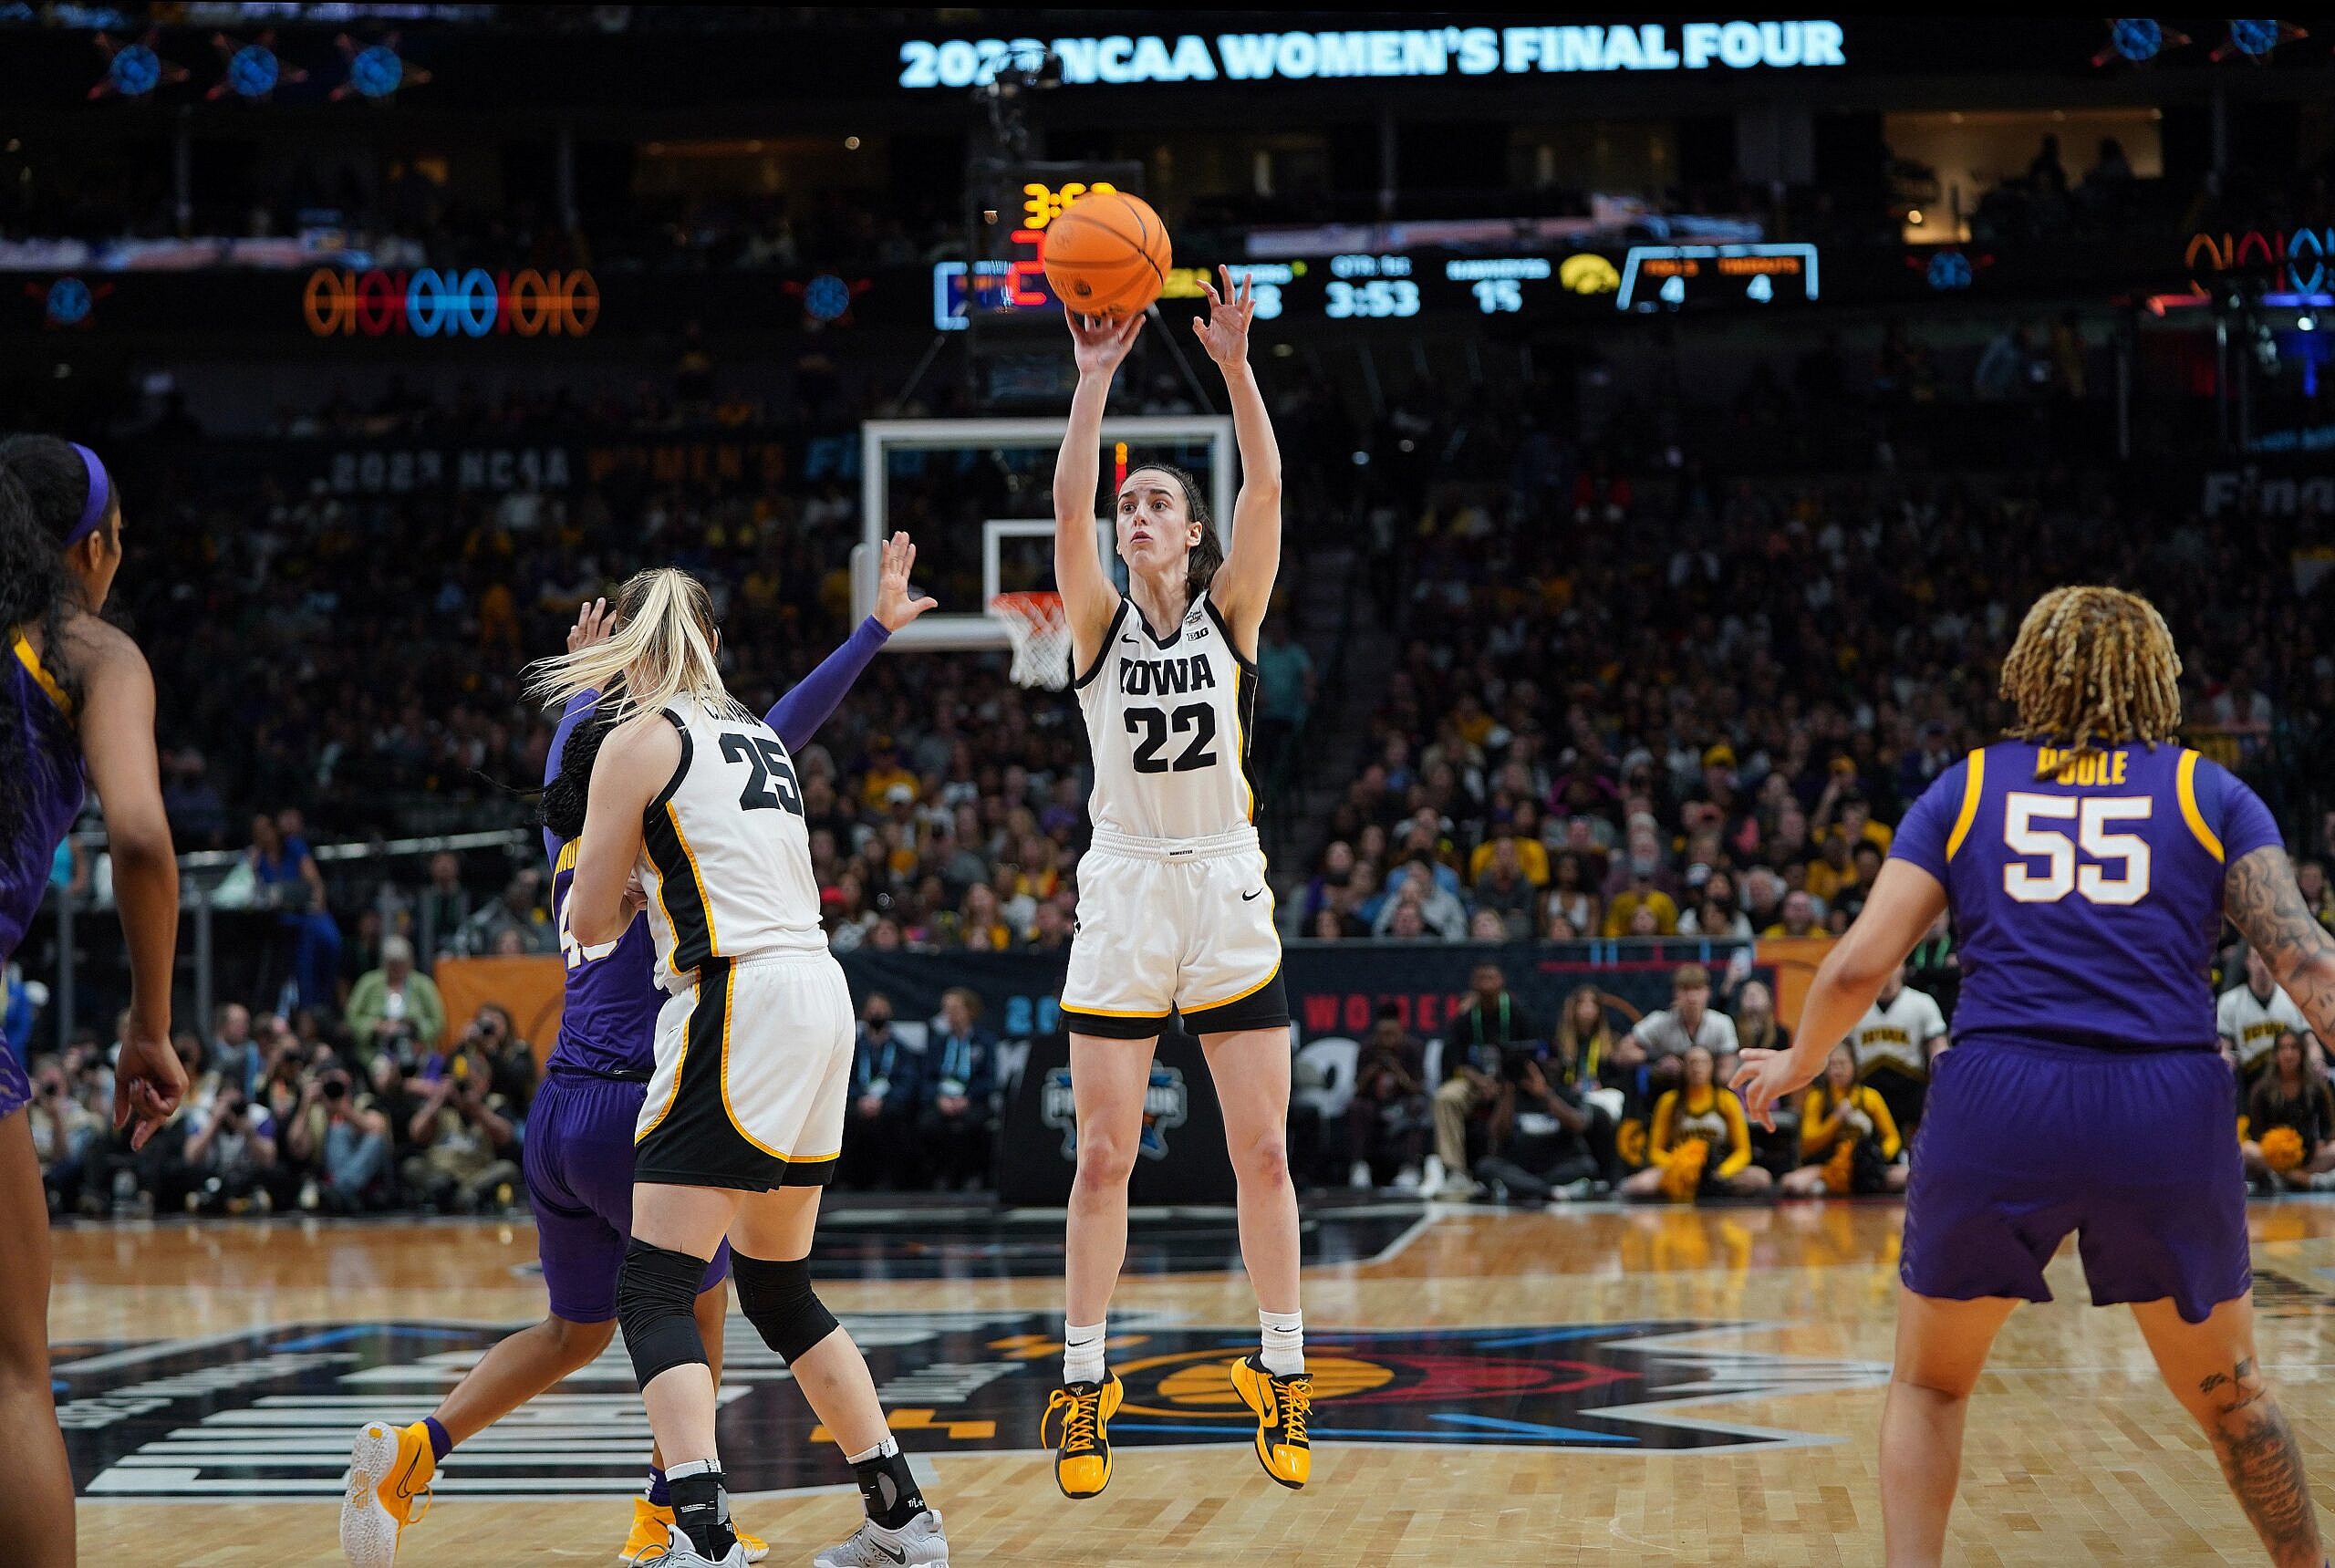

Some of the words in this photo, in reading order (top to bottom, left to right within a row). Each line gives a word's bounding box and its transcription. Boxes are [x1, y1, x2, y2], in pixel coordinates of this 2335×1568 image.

[1051, 35, 1218, 84] NCAA
[1216, 26, 1499, 80] WOMEN'S
[1501, 24, 1678, 73] FINAL
[1682, 20, 1845, 69] FOUR
[1325, 280, 1421, 318] 3:53
[1472, 279, 1522, 313] 15
[1659, 275, 1686, 305] 4
[1746, 273, 1775, 304] 4
[1119, 653, 1216, 696] IOWA
[1123, 701, 1217, 774] 22
[718, 732, 804, 818] 25
[2002, 791, 2153, 905] 55
[558, 882, 619, 970] 4
